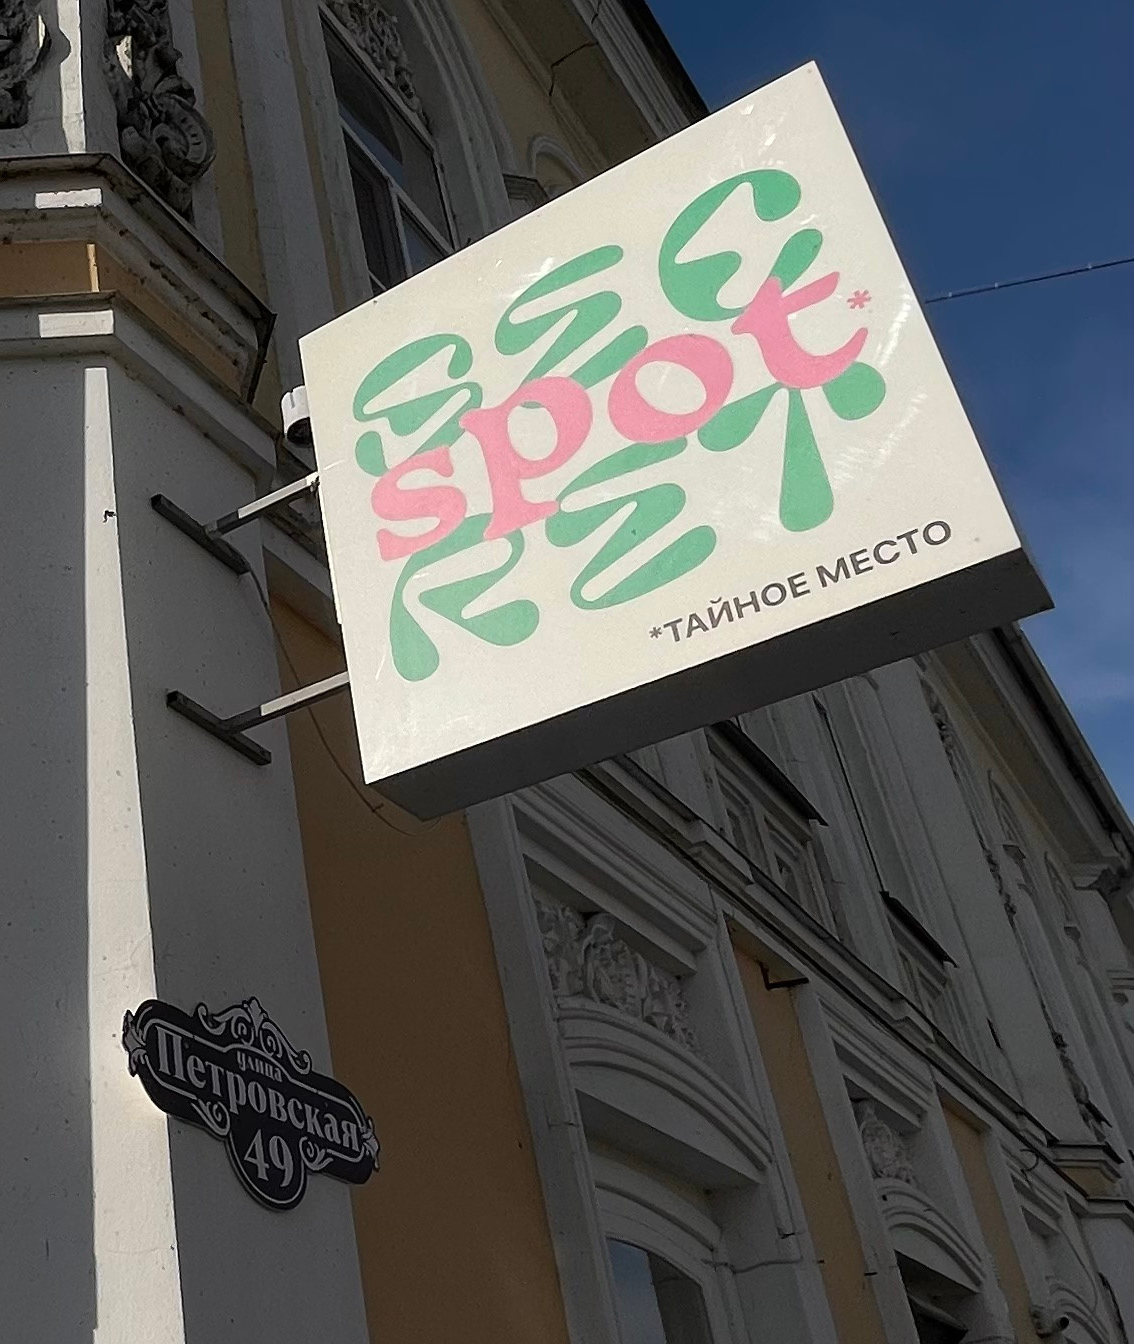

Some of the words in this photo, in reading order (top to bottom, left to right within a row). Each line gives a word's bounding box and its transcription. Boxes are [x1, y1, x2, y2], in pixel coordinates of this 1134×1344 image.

[815, 519, 952, 588] МЕСТО
[155, 1025, 361, 1152] Петровская
[236, 1050, 283, 1083] улица
[243, 1128, 294, 1188] 49
